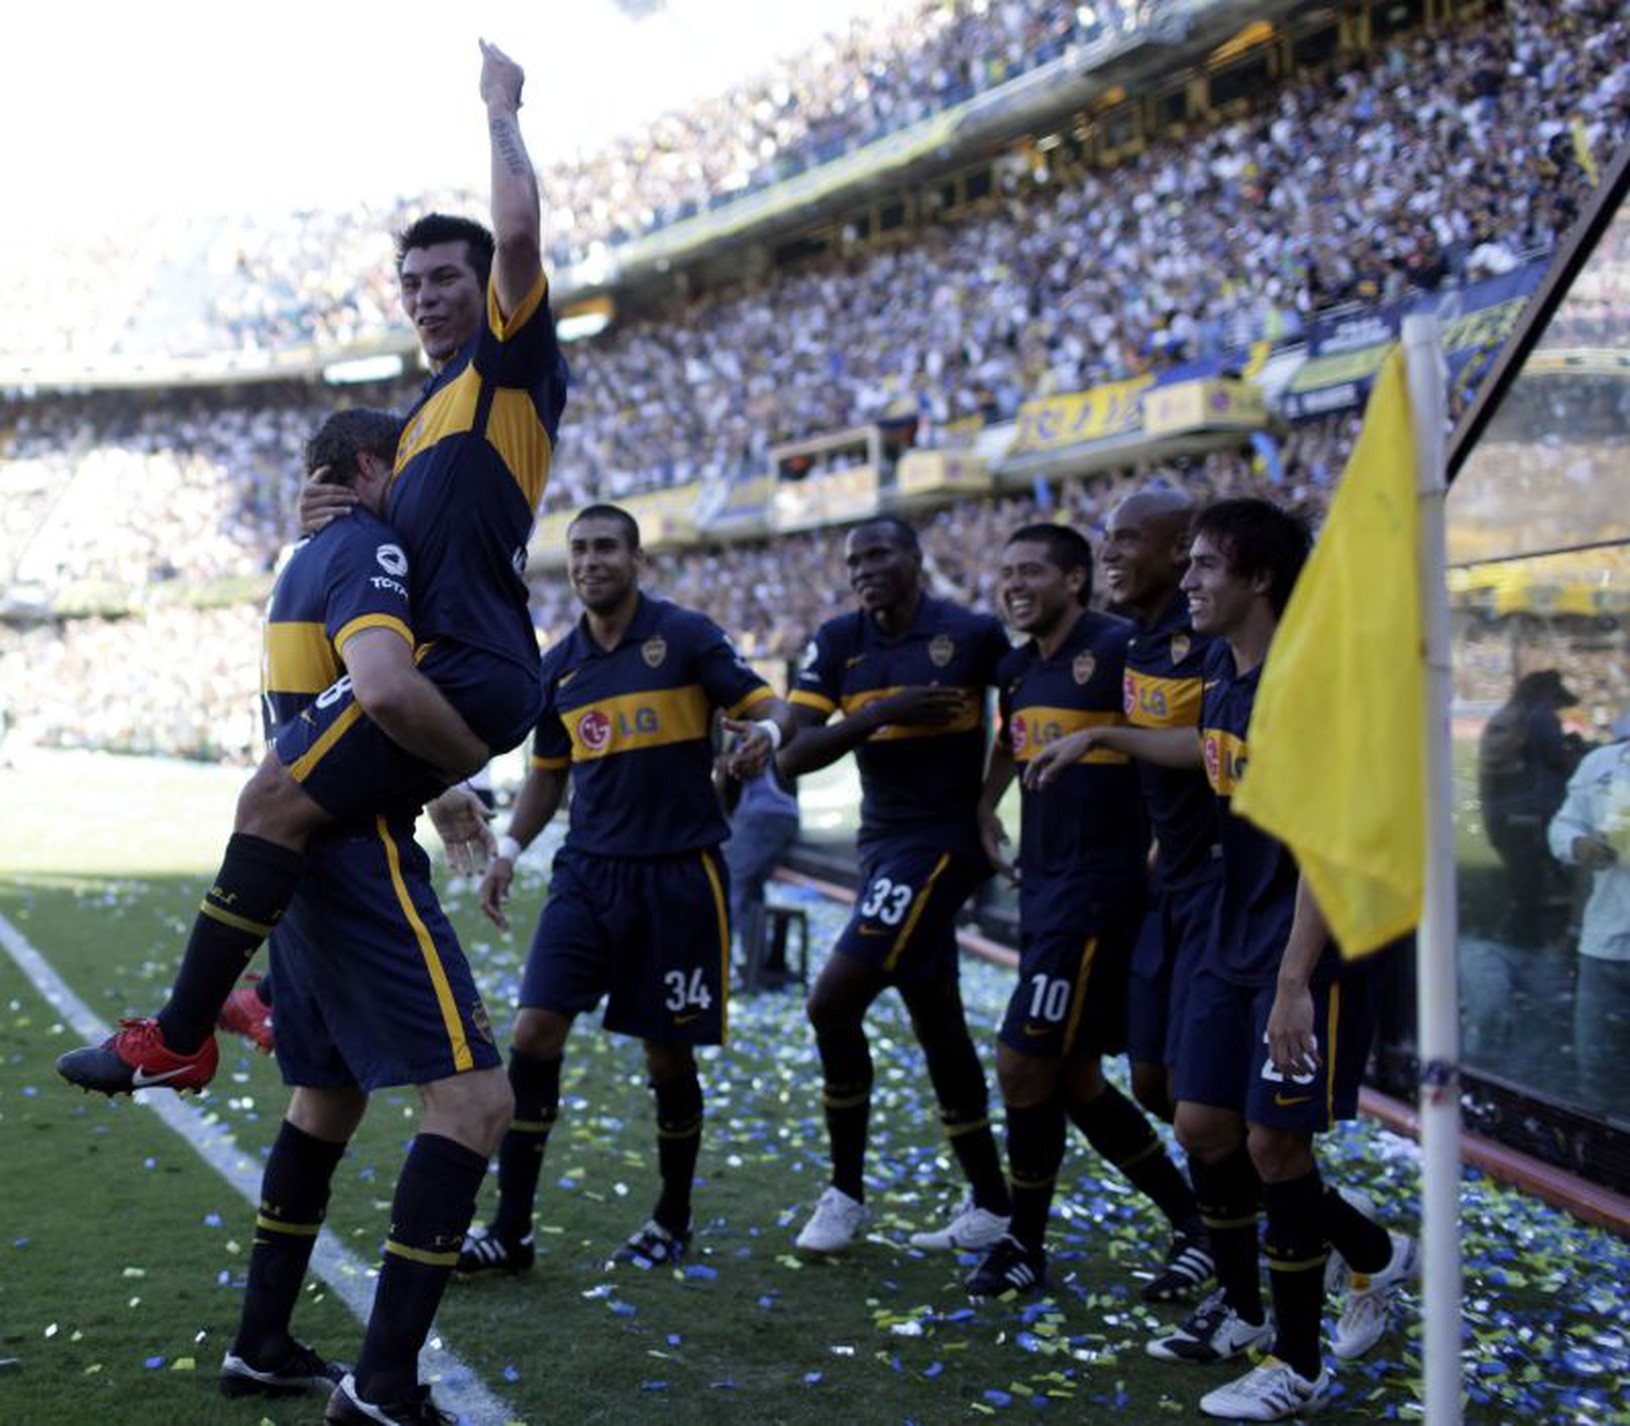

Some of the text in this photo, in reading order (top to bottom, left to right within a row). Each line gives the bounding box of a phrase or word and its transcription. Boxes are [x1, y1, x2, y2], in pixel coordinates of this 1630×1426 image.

[370, 576, 408, 600] TOTA
[1140, 688, 1169, 717] LG
[618, 707, 659, 738] LG
[861, 878, 913, 925] 33
[664, 967, 712, 1011] 34
[1030, 972, 1071, 1022] 10
